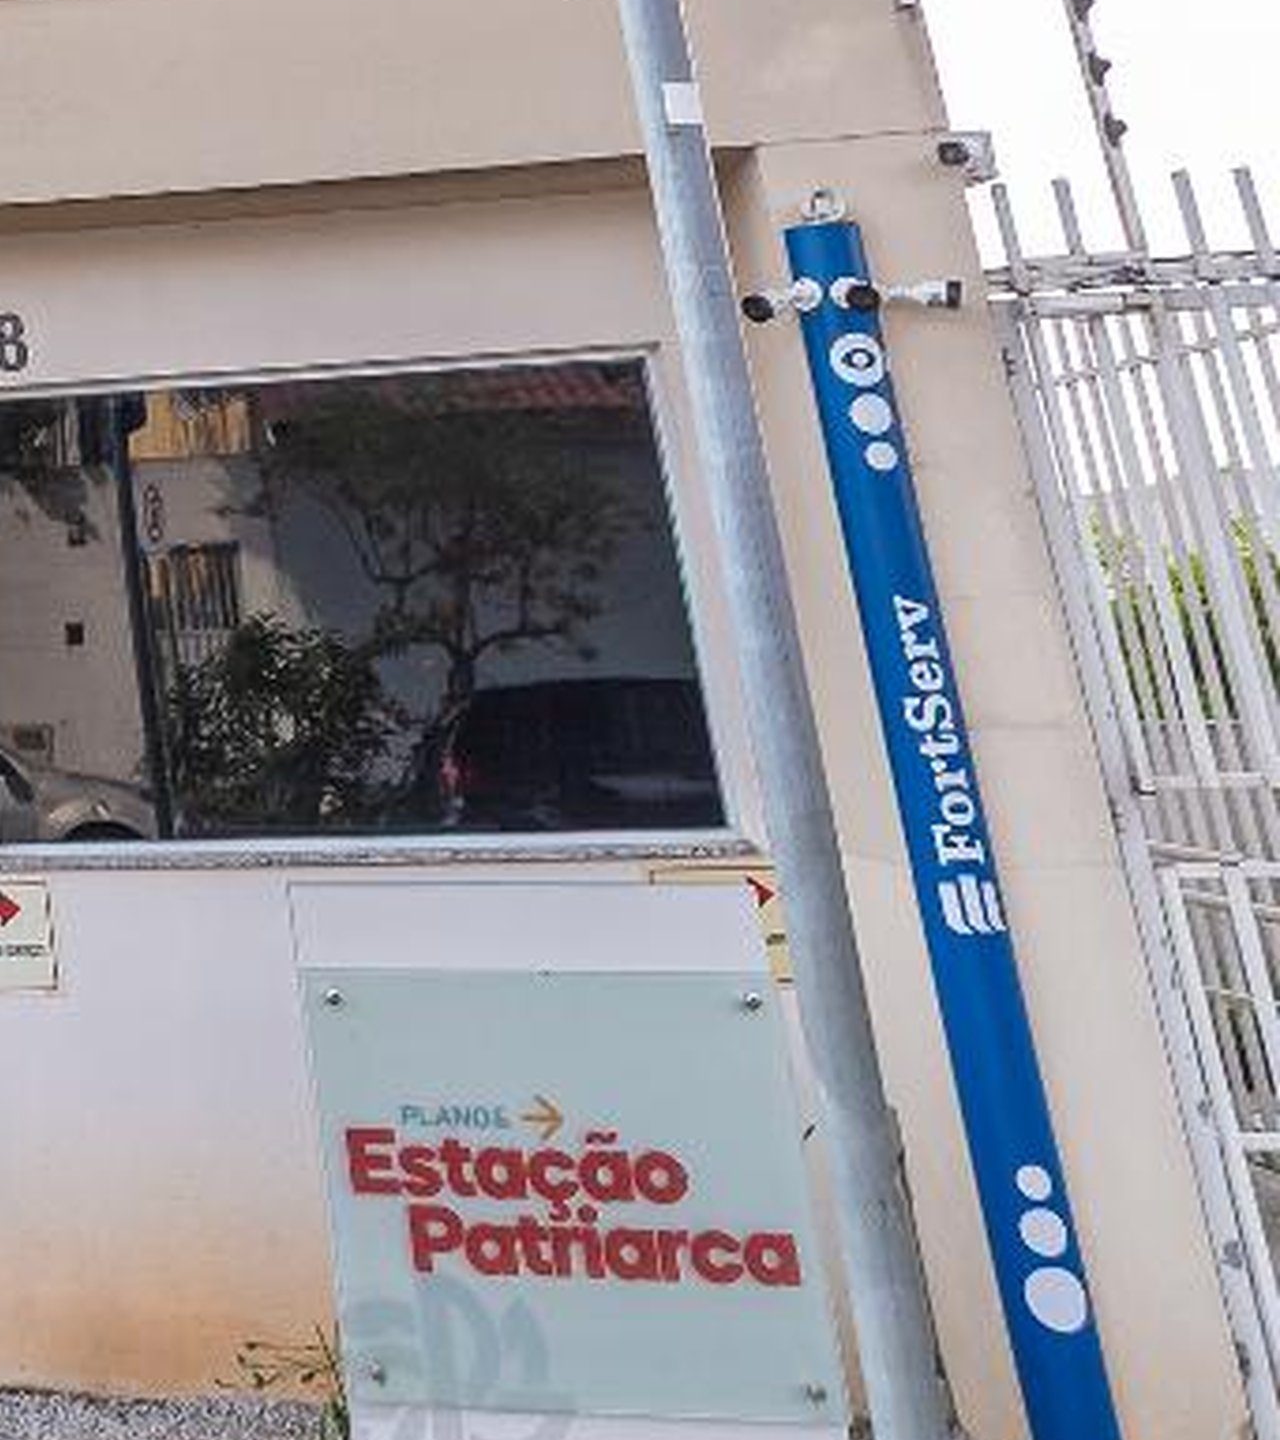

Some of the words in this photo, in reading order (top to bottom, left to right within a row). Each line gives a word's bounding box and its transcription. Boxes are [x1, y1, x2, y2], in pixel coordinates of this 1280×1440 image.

[893, 595, 986, 866] FortServ
[345, 1127, 690, 1221] Estação
[407, 1203, 802, 1287] Patriarca
